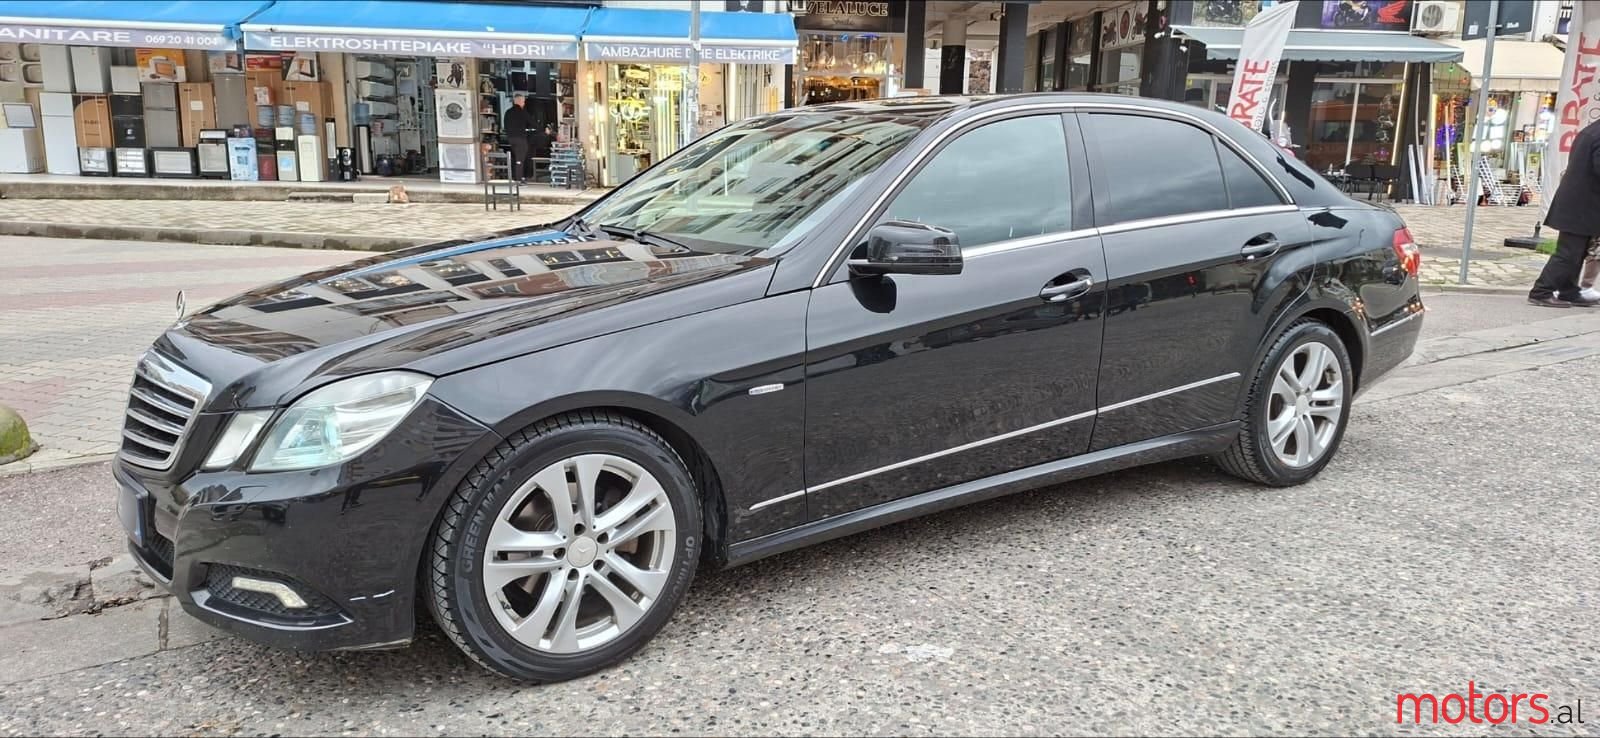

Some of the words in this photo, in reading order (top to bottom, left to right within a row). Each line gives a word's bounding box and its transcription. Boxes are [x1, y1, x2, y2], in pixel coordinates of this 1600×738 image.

[145, 34, 166, 44] 069
[168, 35, 181, 45] 20
[184, 36, 194, 45] 41
[197, 37, 217, 46] 004
[271, 36, 471, 53] ELEKTROSHTEPIAKE
[601, 46, 682, 58] AMBAZHURE
[715, 49, 780, 61] ELEKTRIKE
